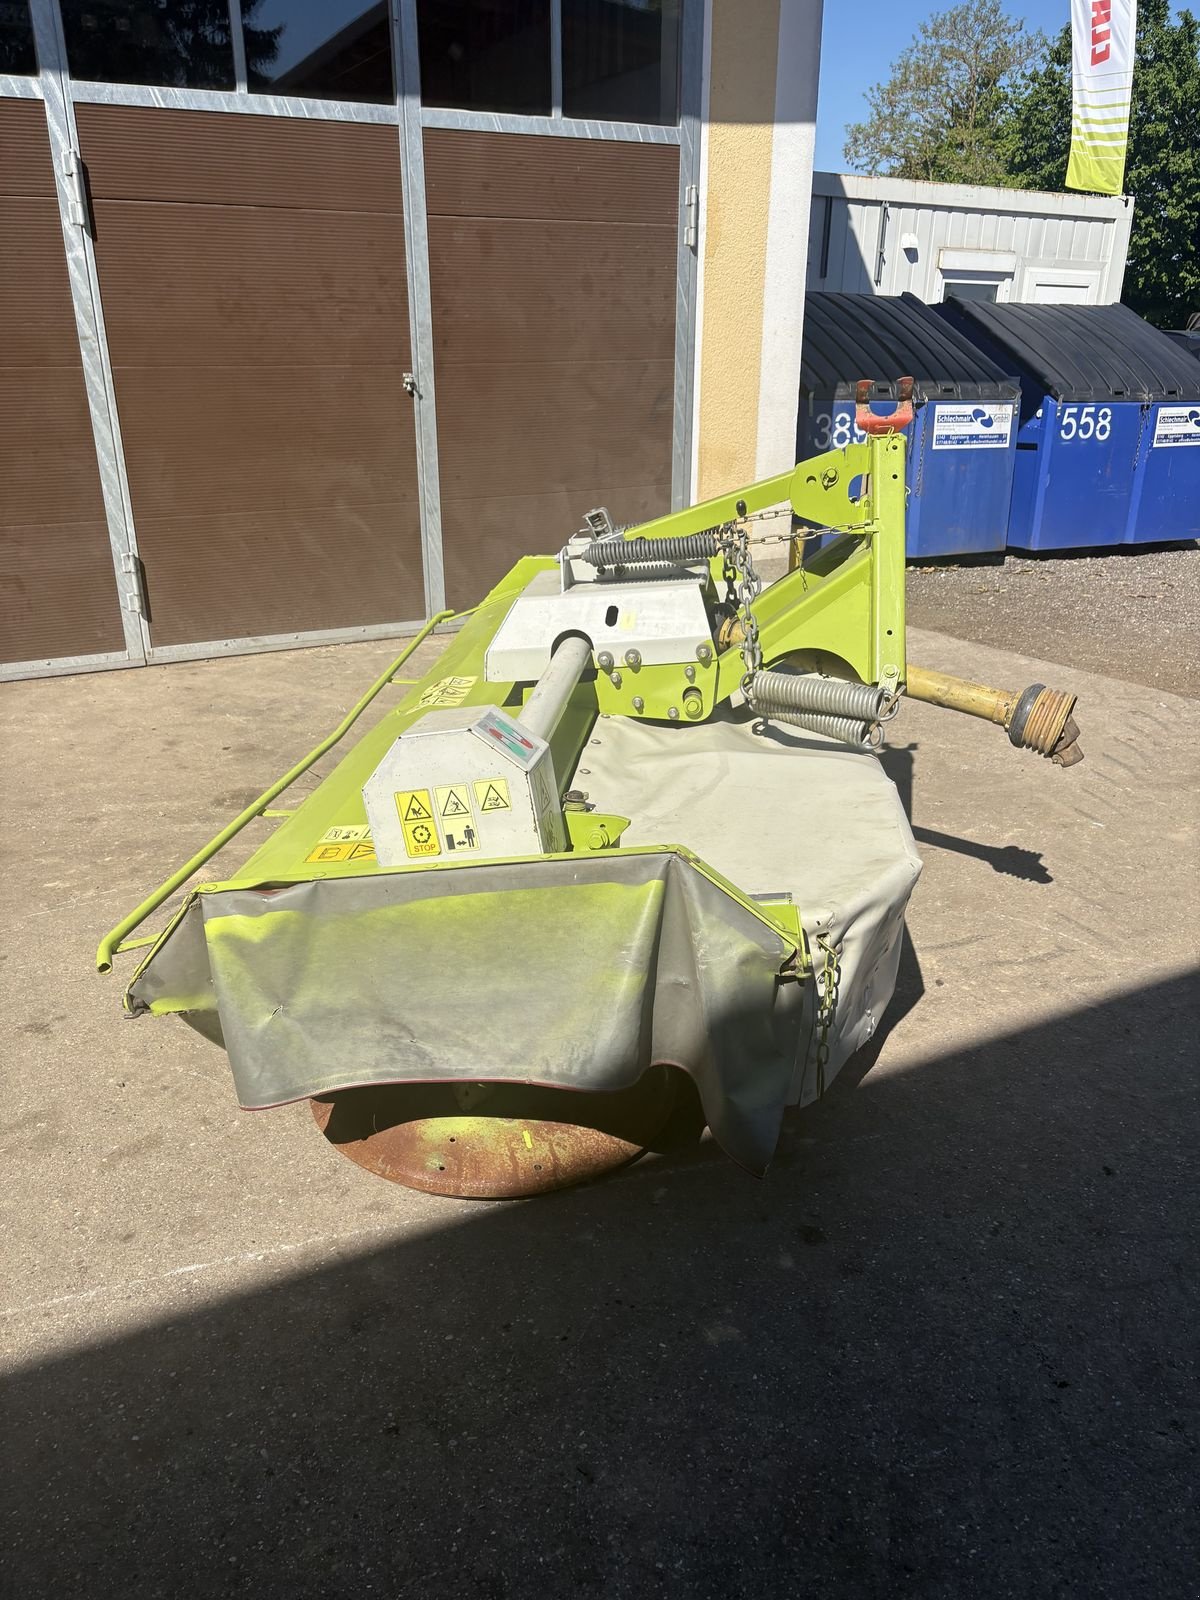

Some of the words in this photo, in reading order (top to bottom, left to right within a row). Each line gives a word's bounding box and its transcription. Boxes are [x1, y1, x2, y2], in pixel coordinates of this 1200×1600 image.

[938, 414, 972, 423] Schlechmair
[1061, 407, 1112, 440] 558
[414, 844, 436, 852] STOP
